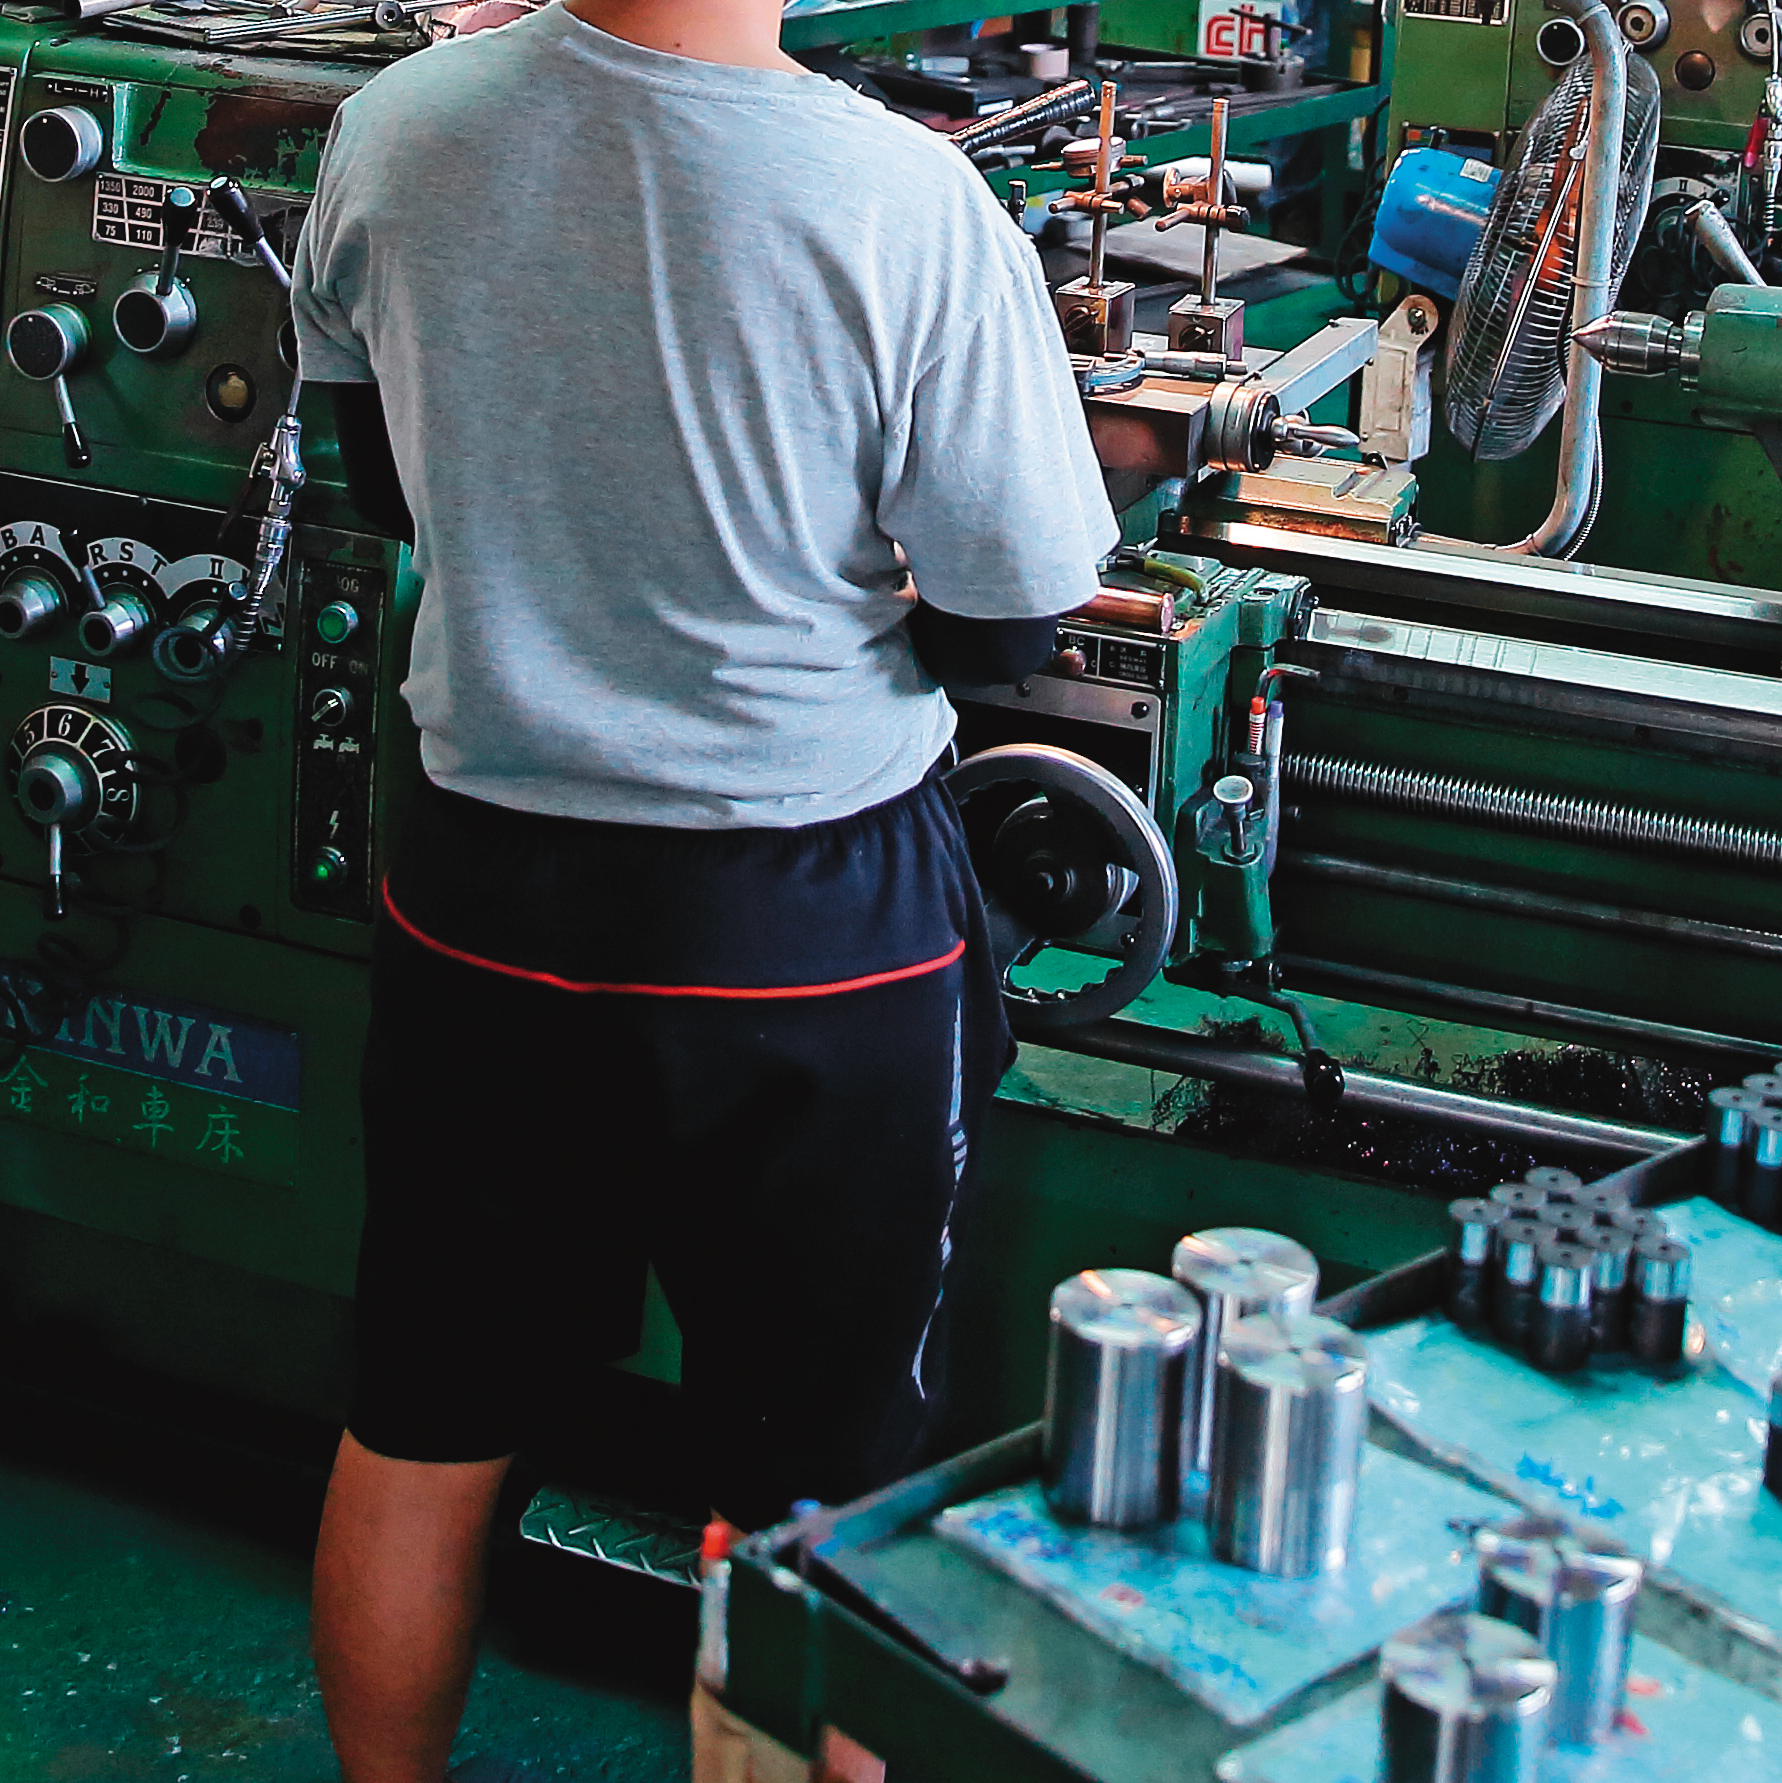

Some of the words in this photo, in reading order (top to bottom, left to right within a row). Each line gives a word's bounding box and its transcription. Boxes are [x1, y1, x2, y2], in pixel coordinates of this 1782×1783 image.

[100, 181, 121, 194] 1350
[132, 185, 155, 198] 2000
[101, 201, 119, 215] 330
[135, 206, 152, 219] 490
[105, 225, 117, 237] 75
[136, 229, 153, 242] 110
[0, 528, 18, 550] B
[29, 525, 46, 546] A
[89, 544, 106, 565] R
[119, 542, 134, 562] S
[152, 554, 168, 576] T
[311, 652, 338, 671] OFF
[58, 713, 72, 737] 6
[24, 723, 36, 745] 5
[92, 739, 115, 760] 7
